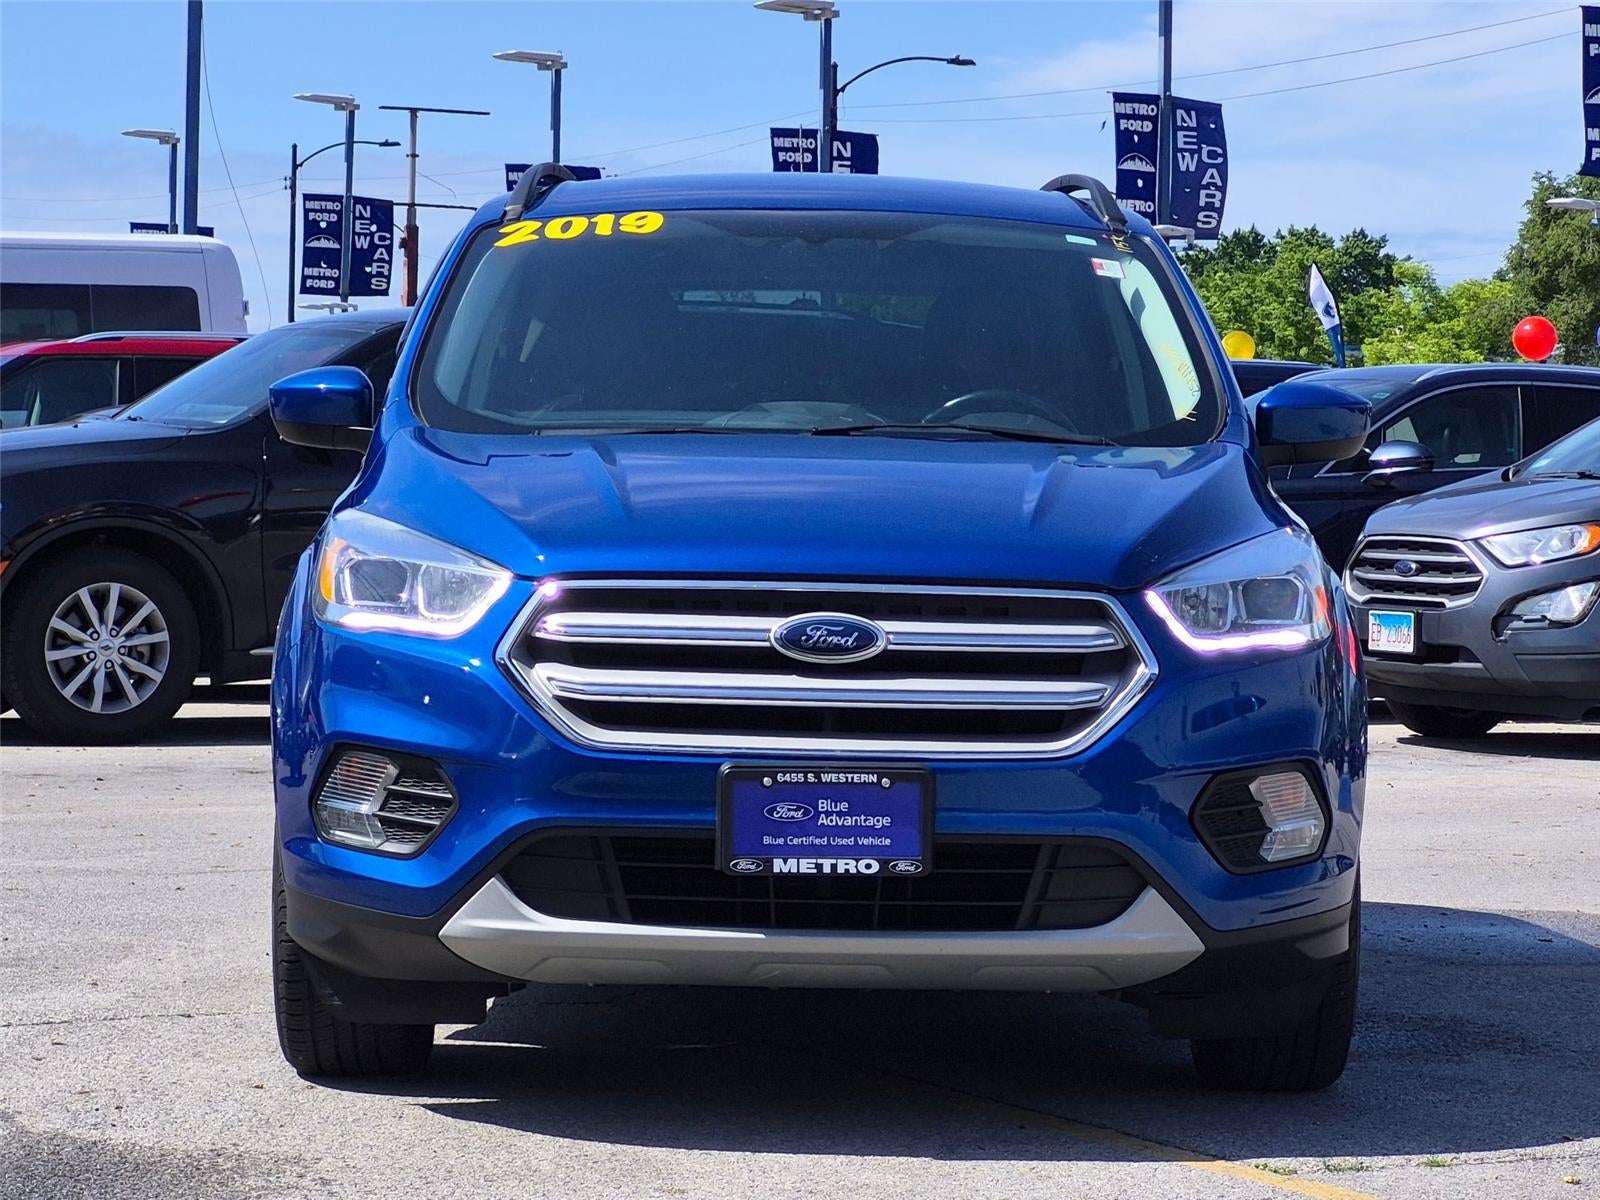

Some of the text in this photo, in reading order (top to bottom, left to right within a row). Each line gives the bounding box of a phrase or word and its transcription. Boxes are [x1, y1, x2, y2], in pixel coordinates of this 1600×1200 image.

[1115, 103, 1157, 116] METRO
[1120, 120, 1153, 132] FORD
[774, 137, 816, 149] METRO
[1176, 109, 1198, 172] NEW
[778, 152, 812, 163] FORD
[1197, 145, 1223, 229] CARS
[305, 201, 341, 210] METRO
[1117, 199, 1154, 212] METRO
[308, 212, 337, 221] FORD
[355, 204, 371, 249] NEW
[494, 212, 664, 247] 2019
[371, 232, 391, 289] CARS
[304, 267, 339, 277] METRO
[306, 279, 335, 288] FORD
[801, 624, 859, 648] Ford
[777, 774, 878, 783] 6455 S. WESTERN
[773, 805, 804, 819] Ford
[818, 800, 849, 811] Blue
[817, 814, 891, 829] Advantage
[763, 836, 891, 846] Blue Certified Used Vehicle
[773, 858, 880, 874] METRO
